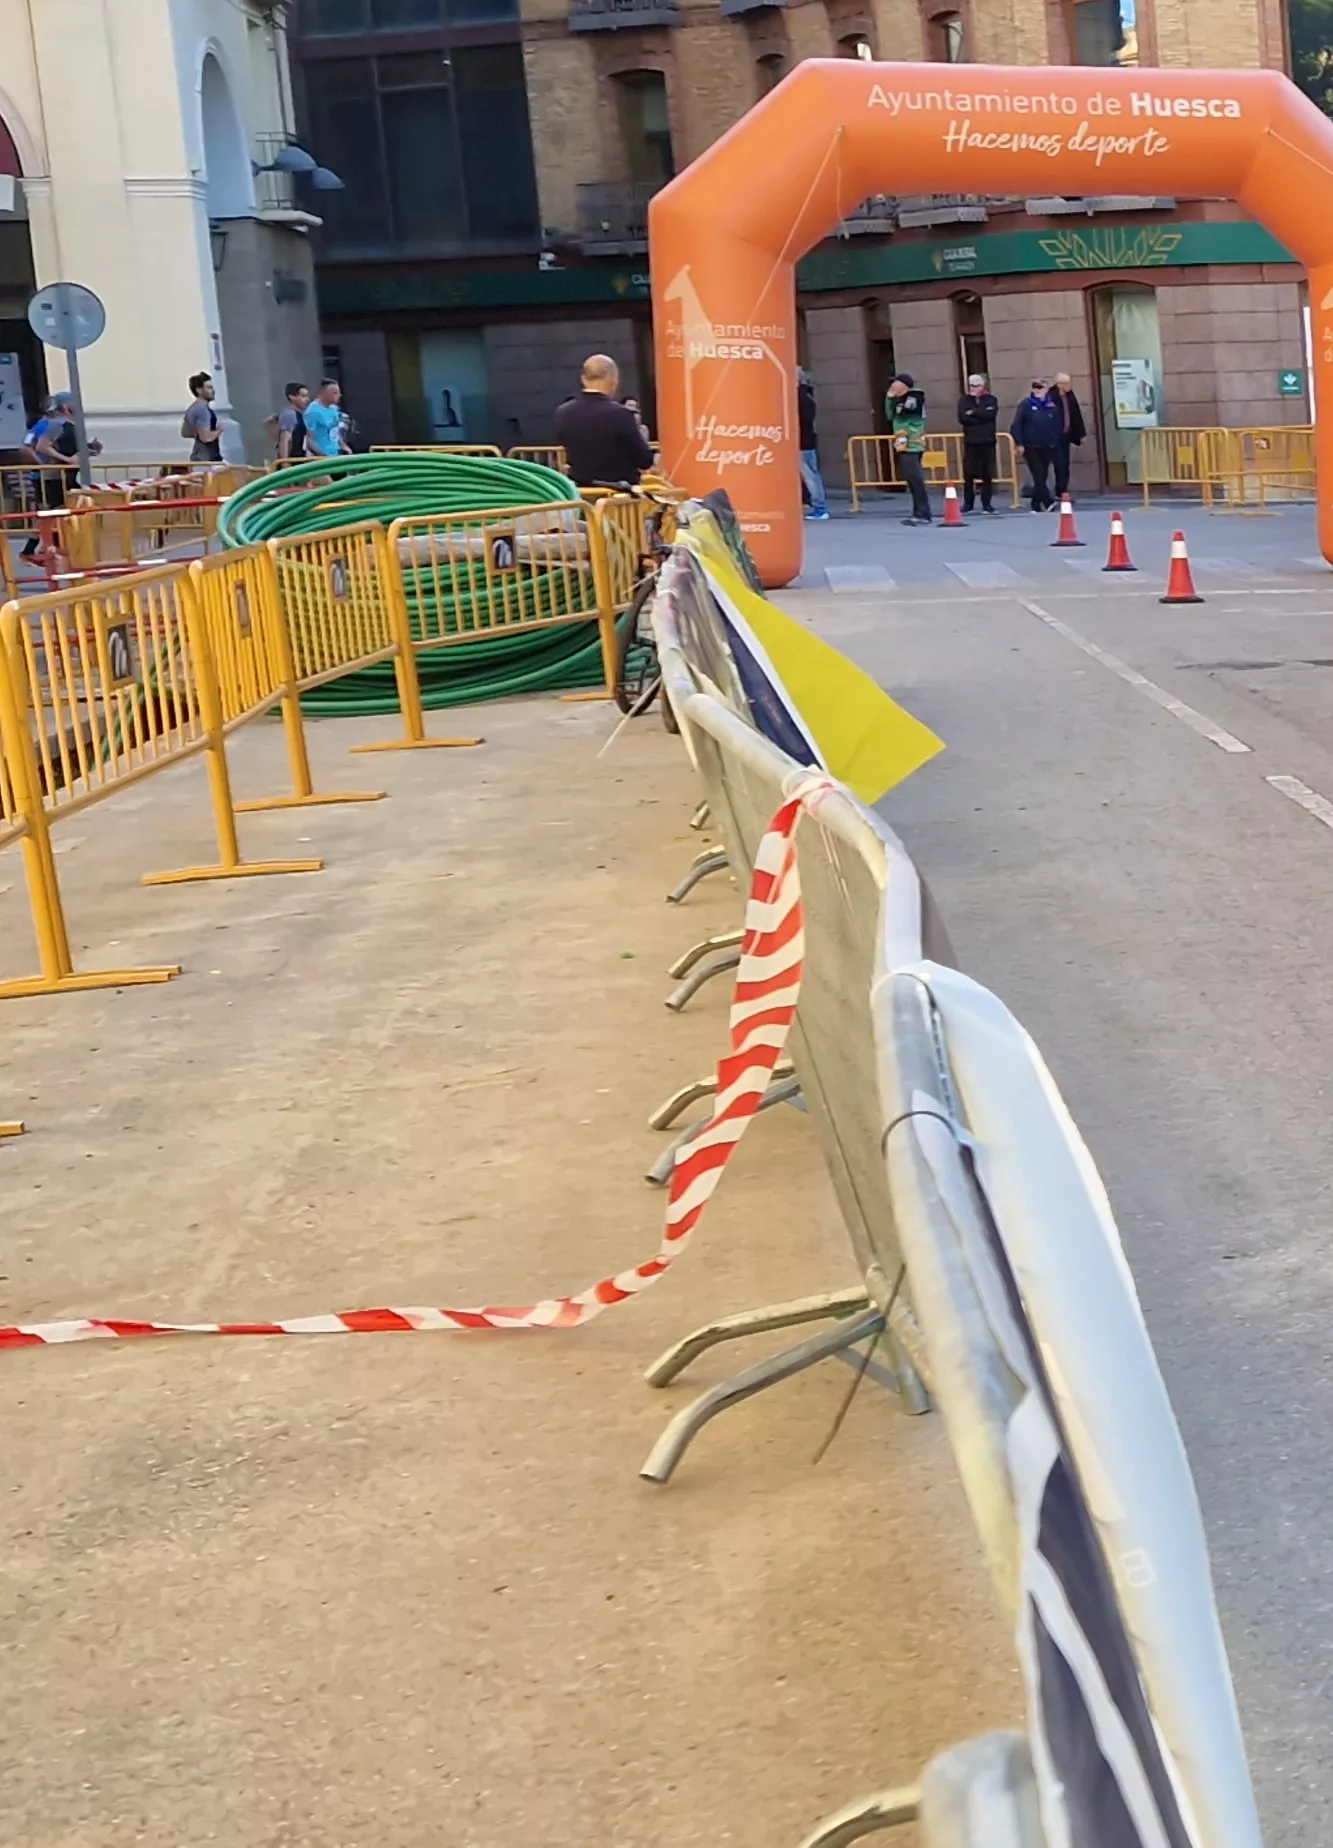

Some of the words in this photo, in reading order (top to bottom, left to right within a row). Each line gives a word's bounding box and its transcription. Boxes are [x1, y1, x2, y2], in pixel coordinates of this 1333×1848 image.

[866, 83, 1078, 116] Ayuntamiento
[1086, 93, 1122, 115] de
[1130, 92, 1242, 118] Huesca
[942, 119, 1064, 157] Hacemos
[1067, 121, 1170, 167] deporte
[665, 319, 787, 340] Ayuntamiento
[666, 342, 683, 358] de
[689, 341, 764, 360] Huesca
[695, 415, 784, 444] Hacemos
[695, 440, 775, 476] deporte
